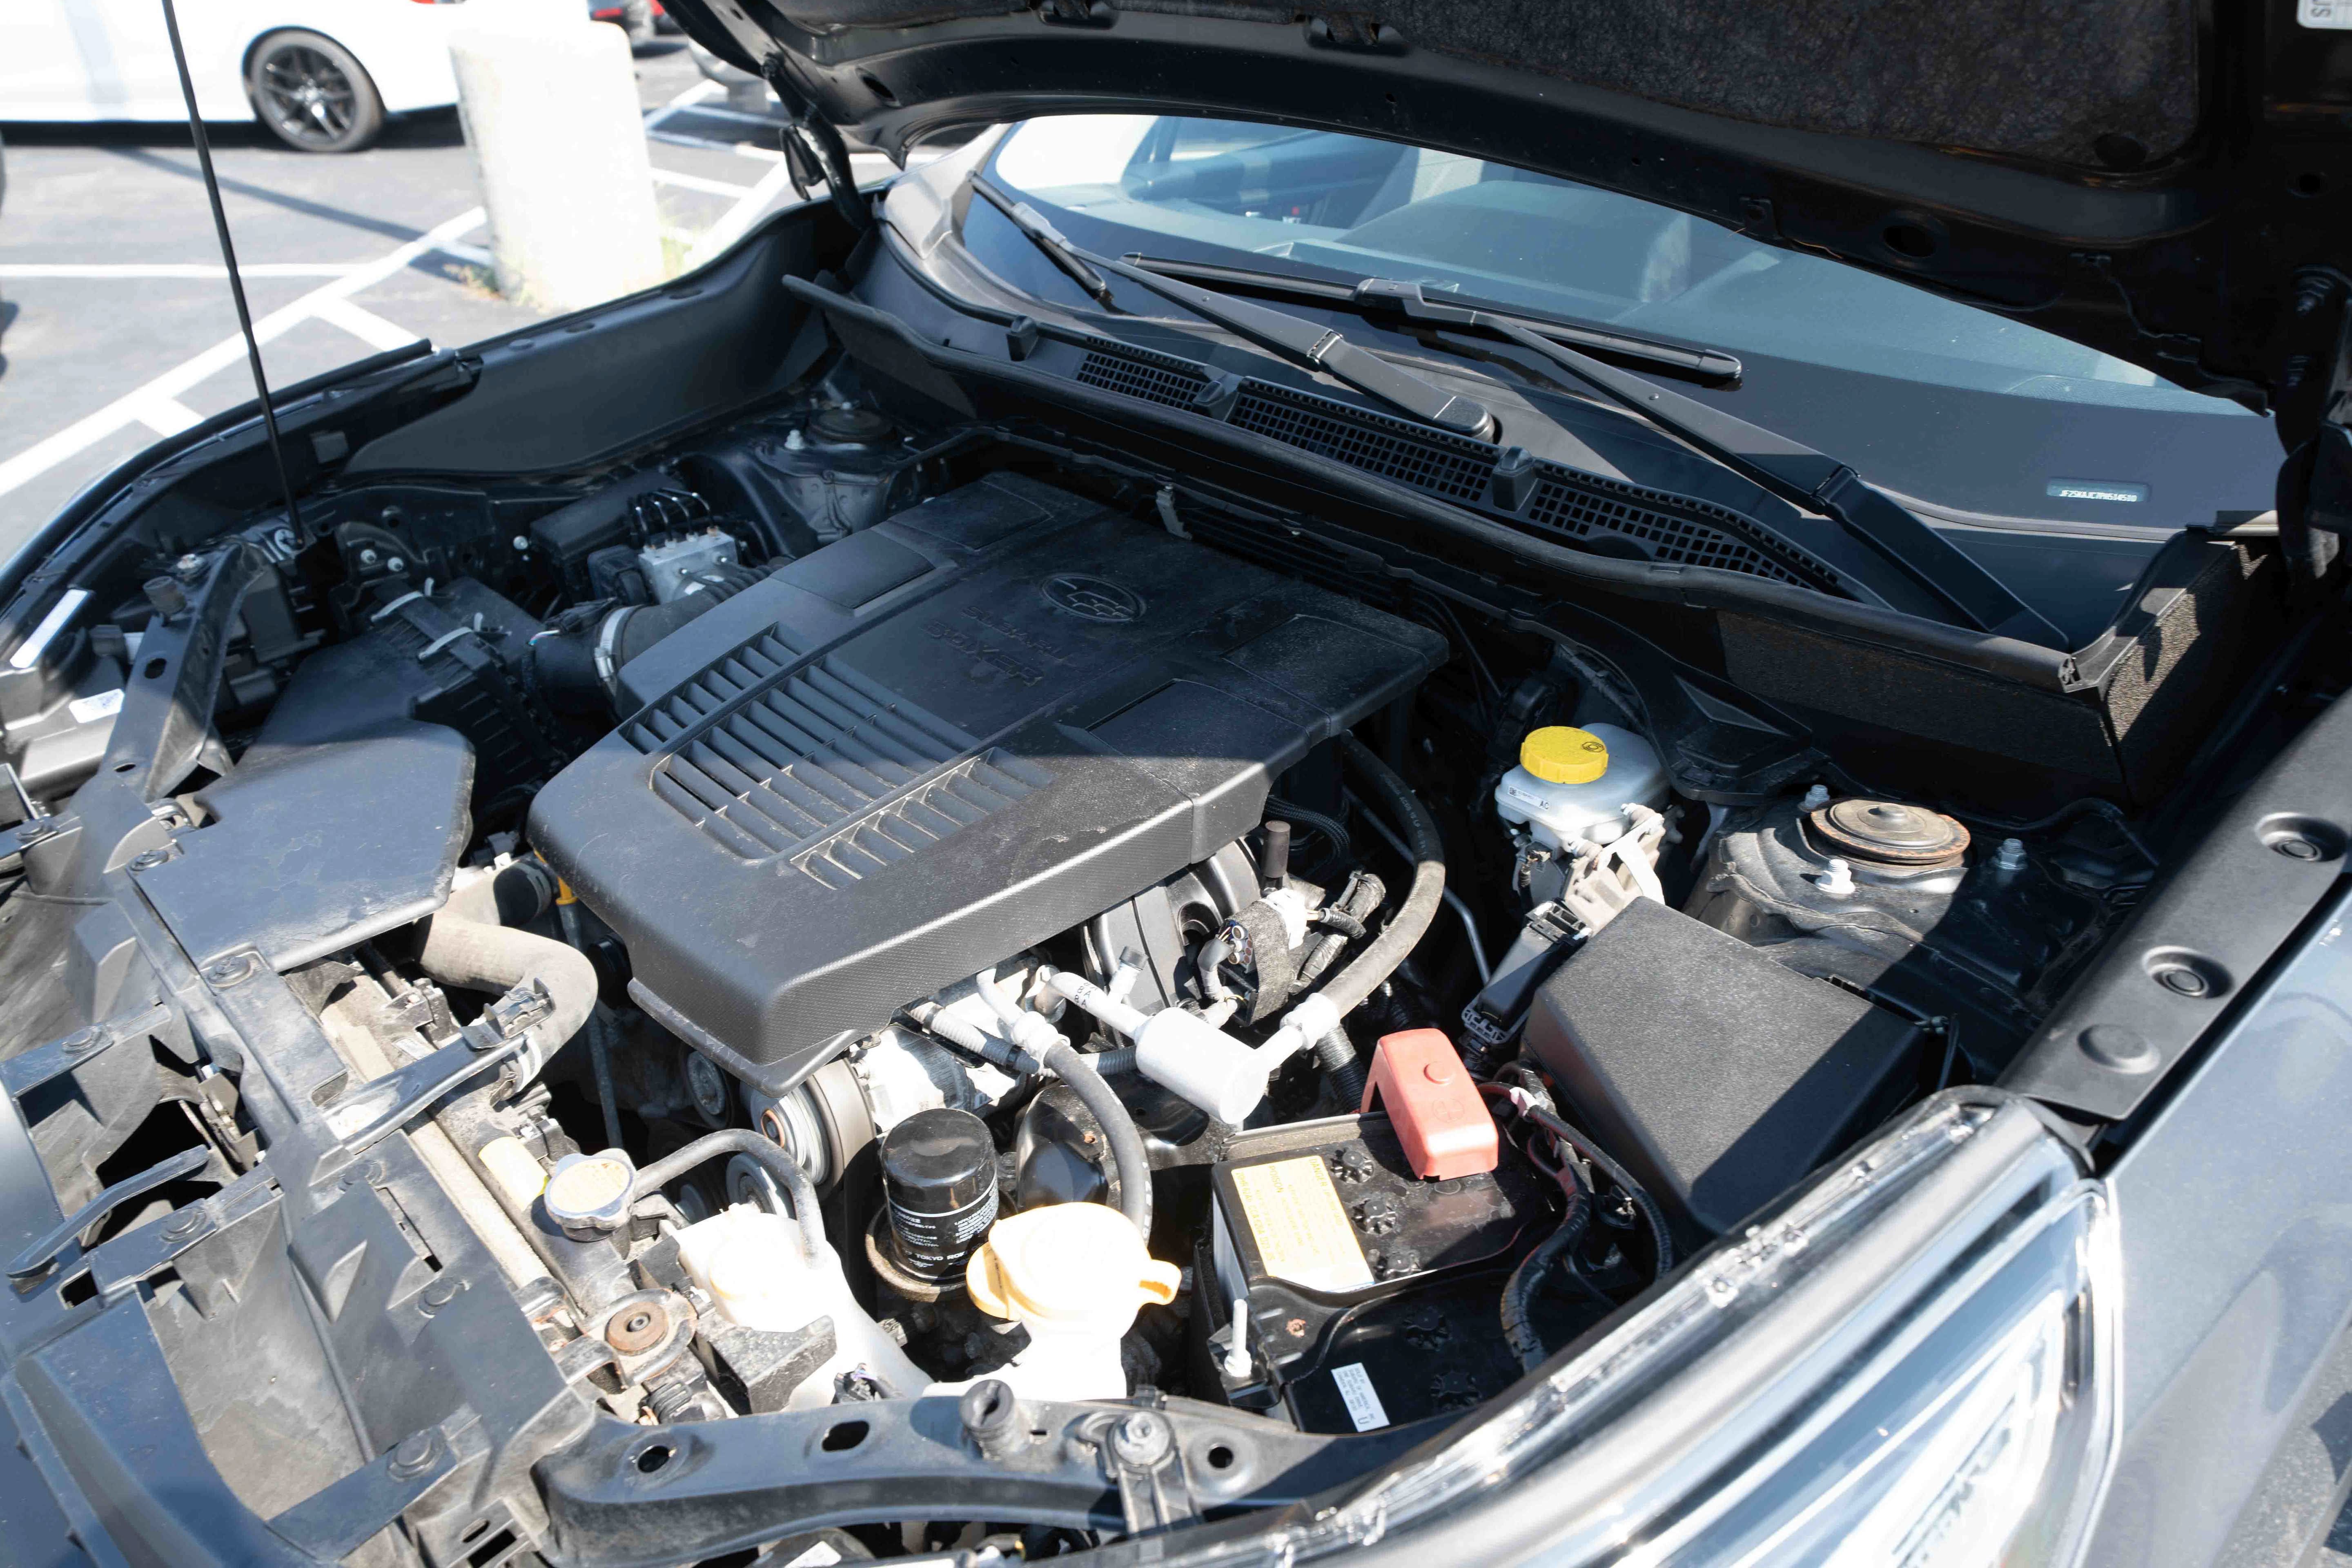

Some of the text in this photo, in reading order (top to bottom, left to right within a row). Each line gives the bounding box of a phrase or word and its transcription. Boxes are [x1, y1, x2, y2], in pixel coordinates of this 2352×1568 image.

[1268, 1165, 1284, 1193] POISON
[1309, 1158, 1328, 1187] DANGER
[915, 1253, 944, 1261] TOKYO
